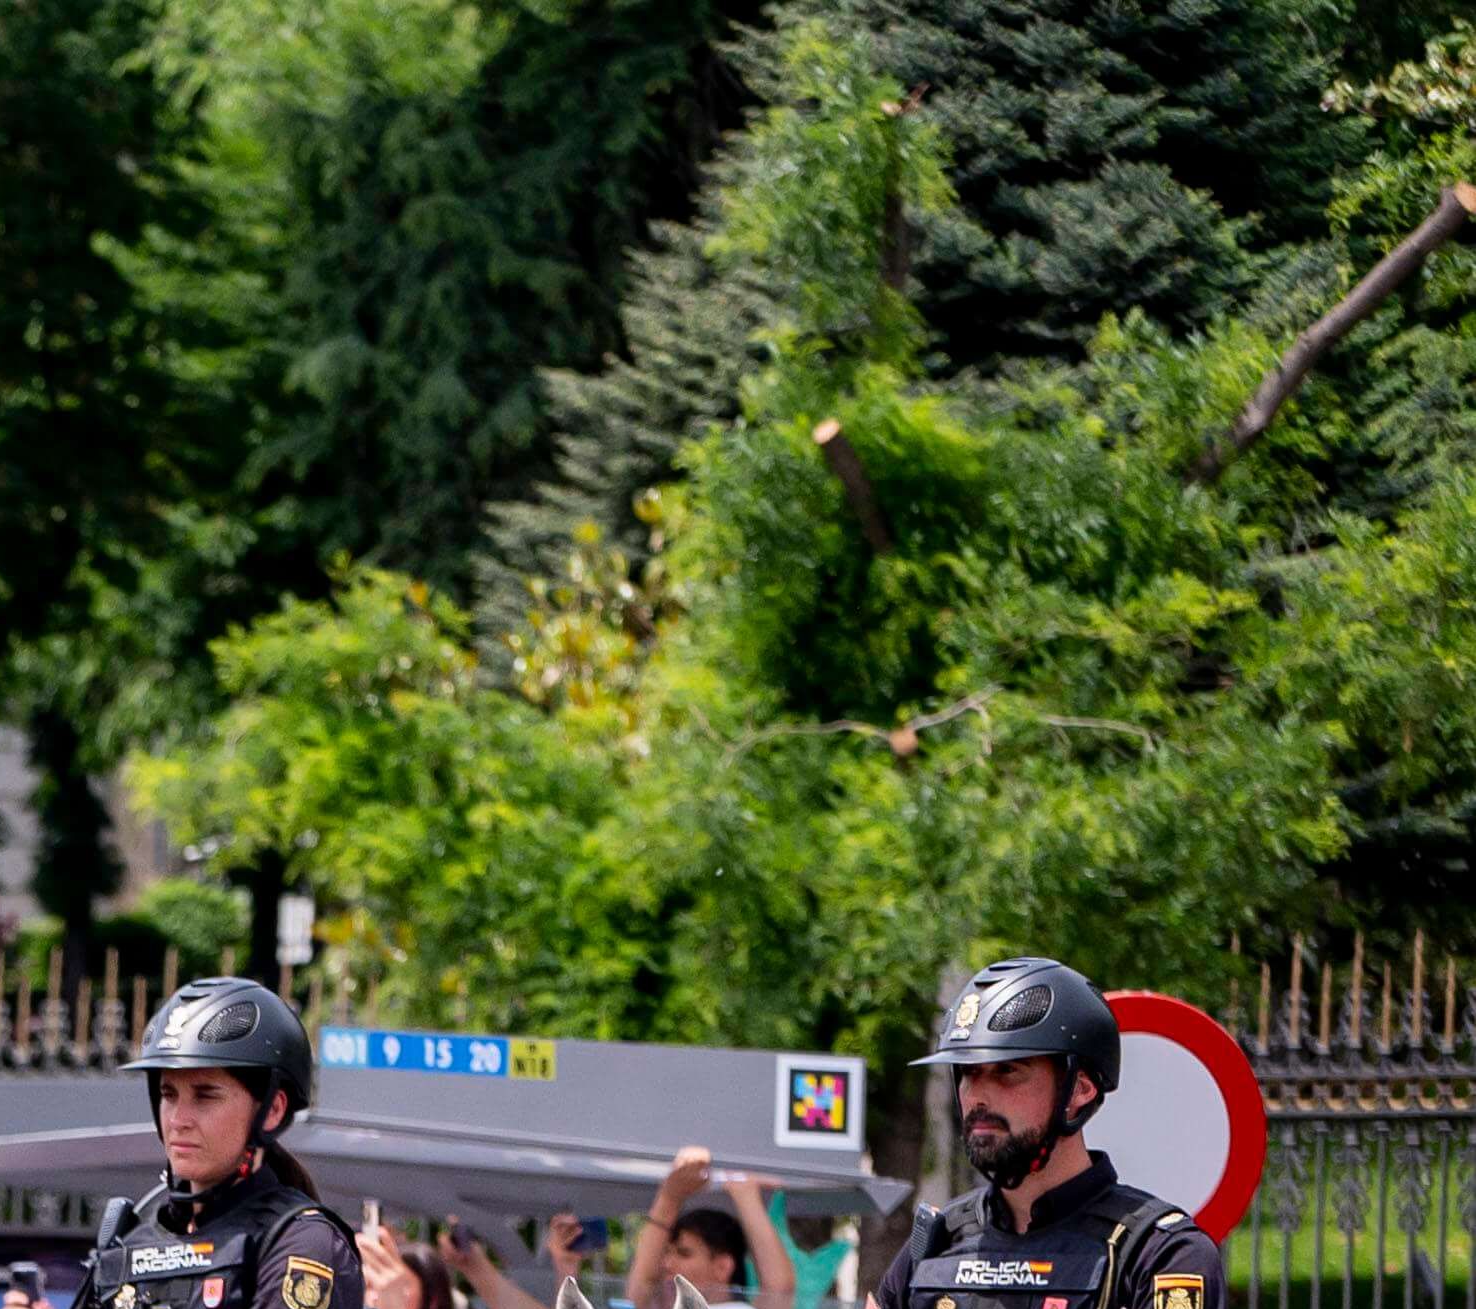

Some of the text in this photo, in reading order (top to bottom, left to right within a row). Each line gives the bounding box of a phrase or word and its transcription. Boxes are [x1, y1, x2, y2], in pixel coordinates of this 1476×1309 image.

[324, 1032, 367, 1065] 001
[382, 1034, 402, 1066] 9
[424, 1037, 454, 1069] 15
[469, 1040, 503, 1074] 20
[957, 1260, 1032, 1273] POLICIA
[954, 1271, 1049, 1286] NACIONAL
